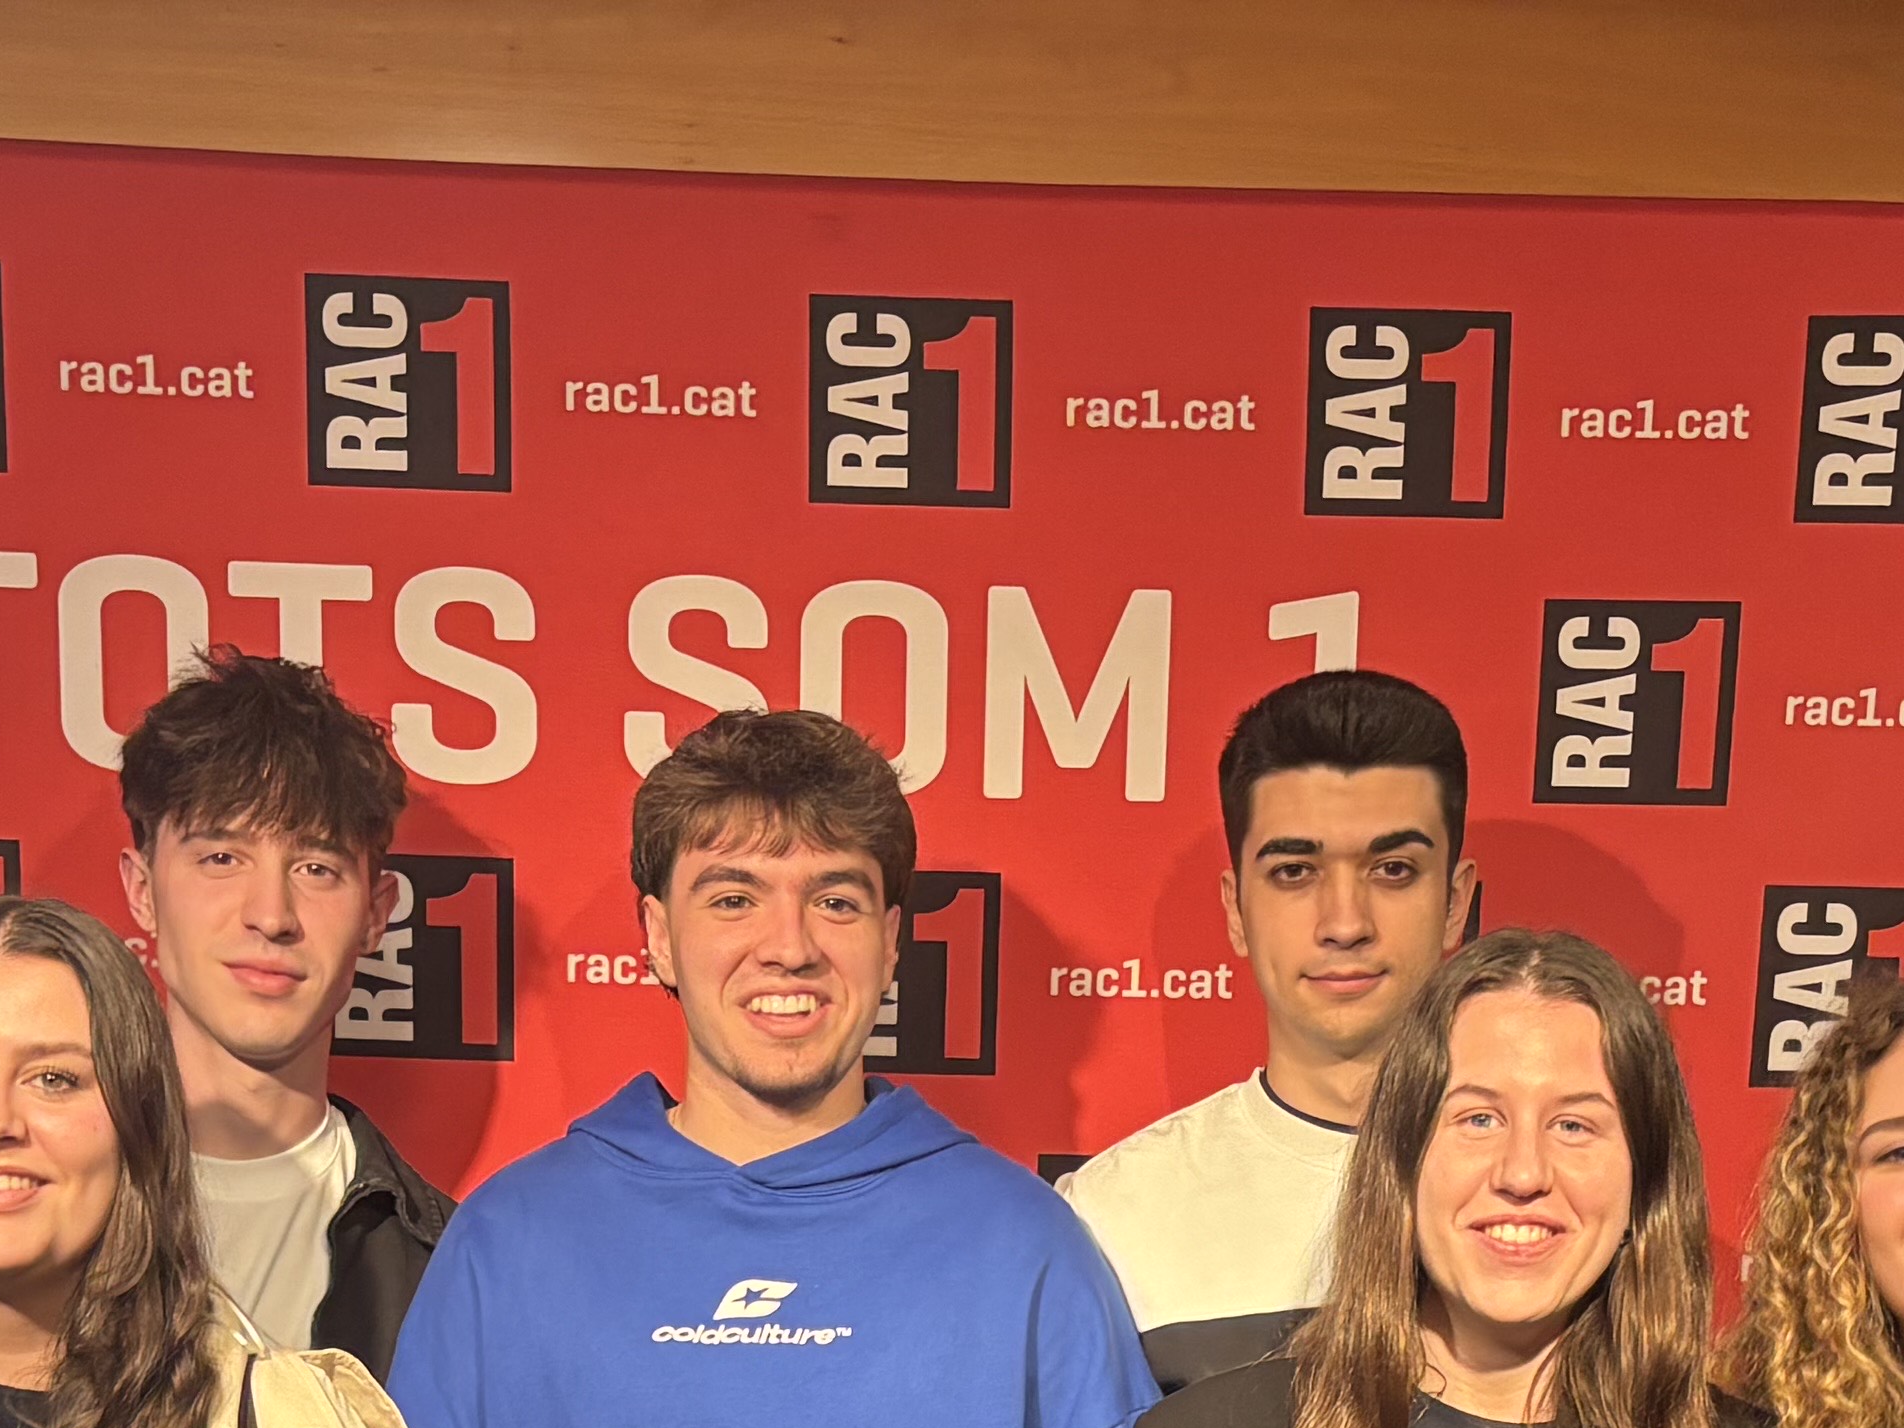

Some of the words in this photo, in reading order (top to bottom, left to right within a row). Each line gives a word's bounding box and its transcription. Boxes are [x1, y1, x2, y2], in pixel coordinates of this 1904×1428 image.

[60, 355, 253, 398] rac1.cat
[323, 292, 407, 471] RAC
[421, 298, 495, 475] 1
[566, 375, 756, 417] rac1.cat
[826, 313, 910, 488] RAC
[924, 317, 996, 492] 1
[1067, 390, 1255, 430] rac1.cat
[1323, 325, 1409, 499] RAC
[1422, 329, 1495, 502] 1
[1561, 400, 1749, 439] rac1.cat
[624, 575, 1172, 802] SOM
[1551, 617, 1640, 787] RAC
[1652, 619, 1724, 789] 1
[427, 874, 499, 1045] 1
[913, 889, 985, 1059] 1
[1051, 959, 1232, 998] rac1.cat
